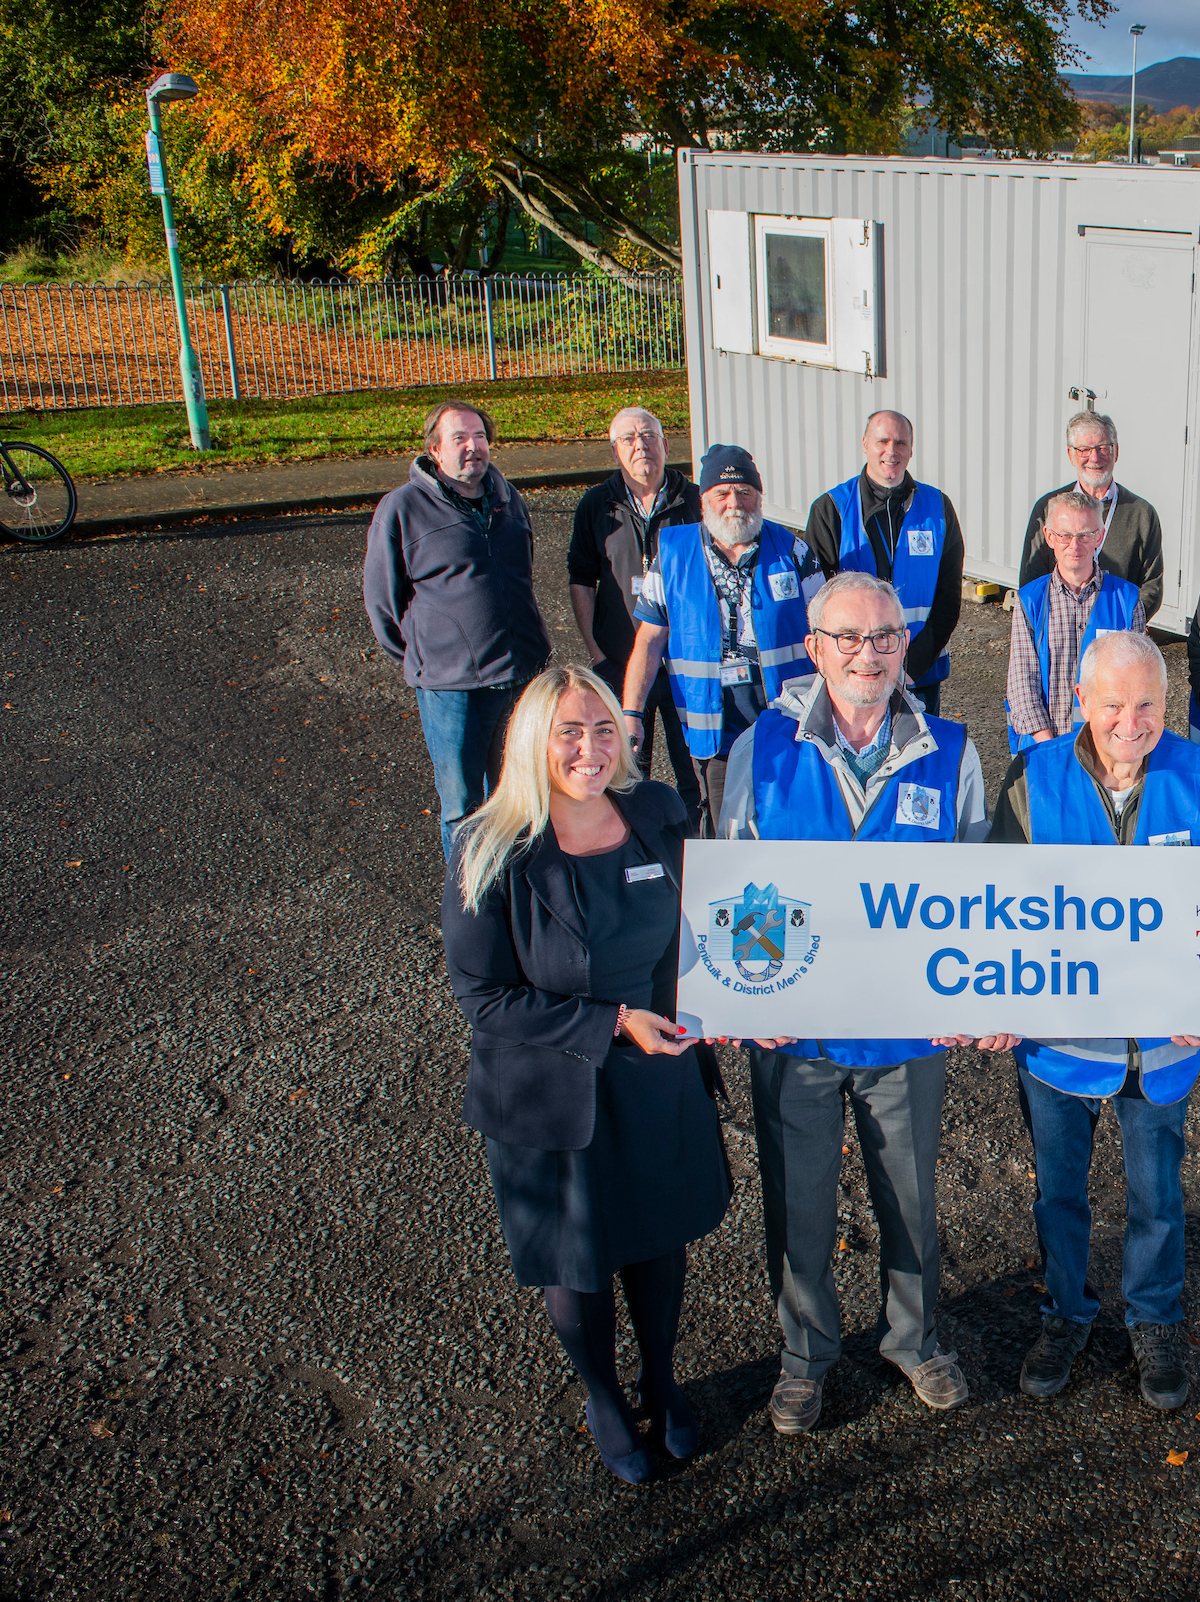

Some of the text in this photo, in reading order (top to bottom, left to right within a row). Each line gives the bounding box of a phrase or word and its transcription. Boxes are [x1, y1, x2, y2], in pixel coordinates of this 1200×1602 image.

[859, 882, 1163, 942] Workshop
[697, 934, 821, 996] Penicuik & District Men's Shed
[926, 947, 1100, 997] Cabin
